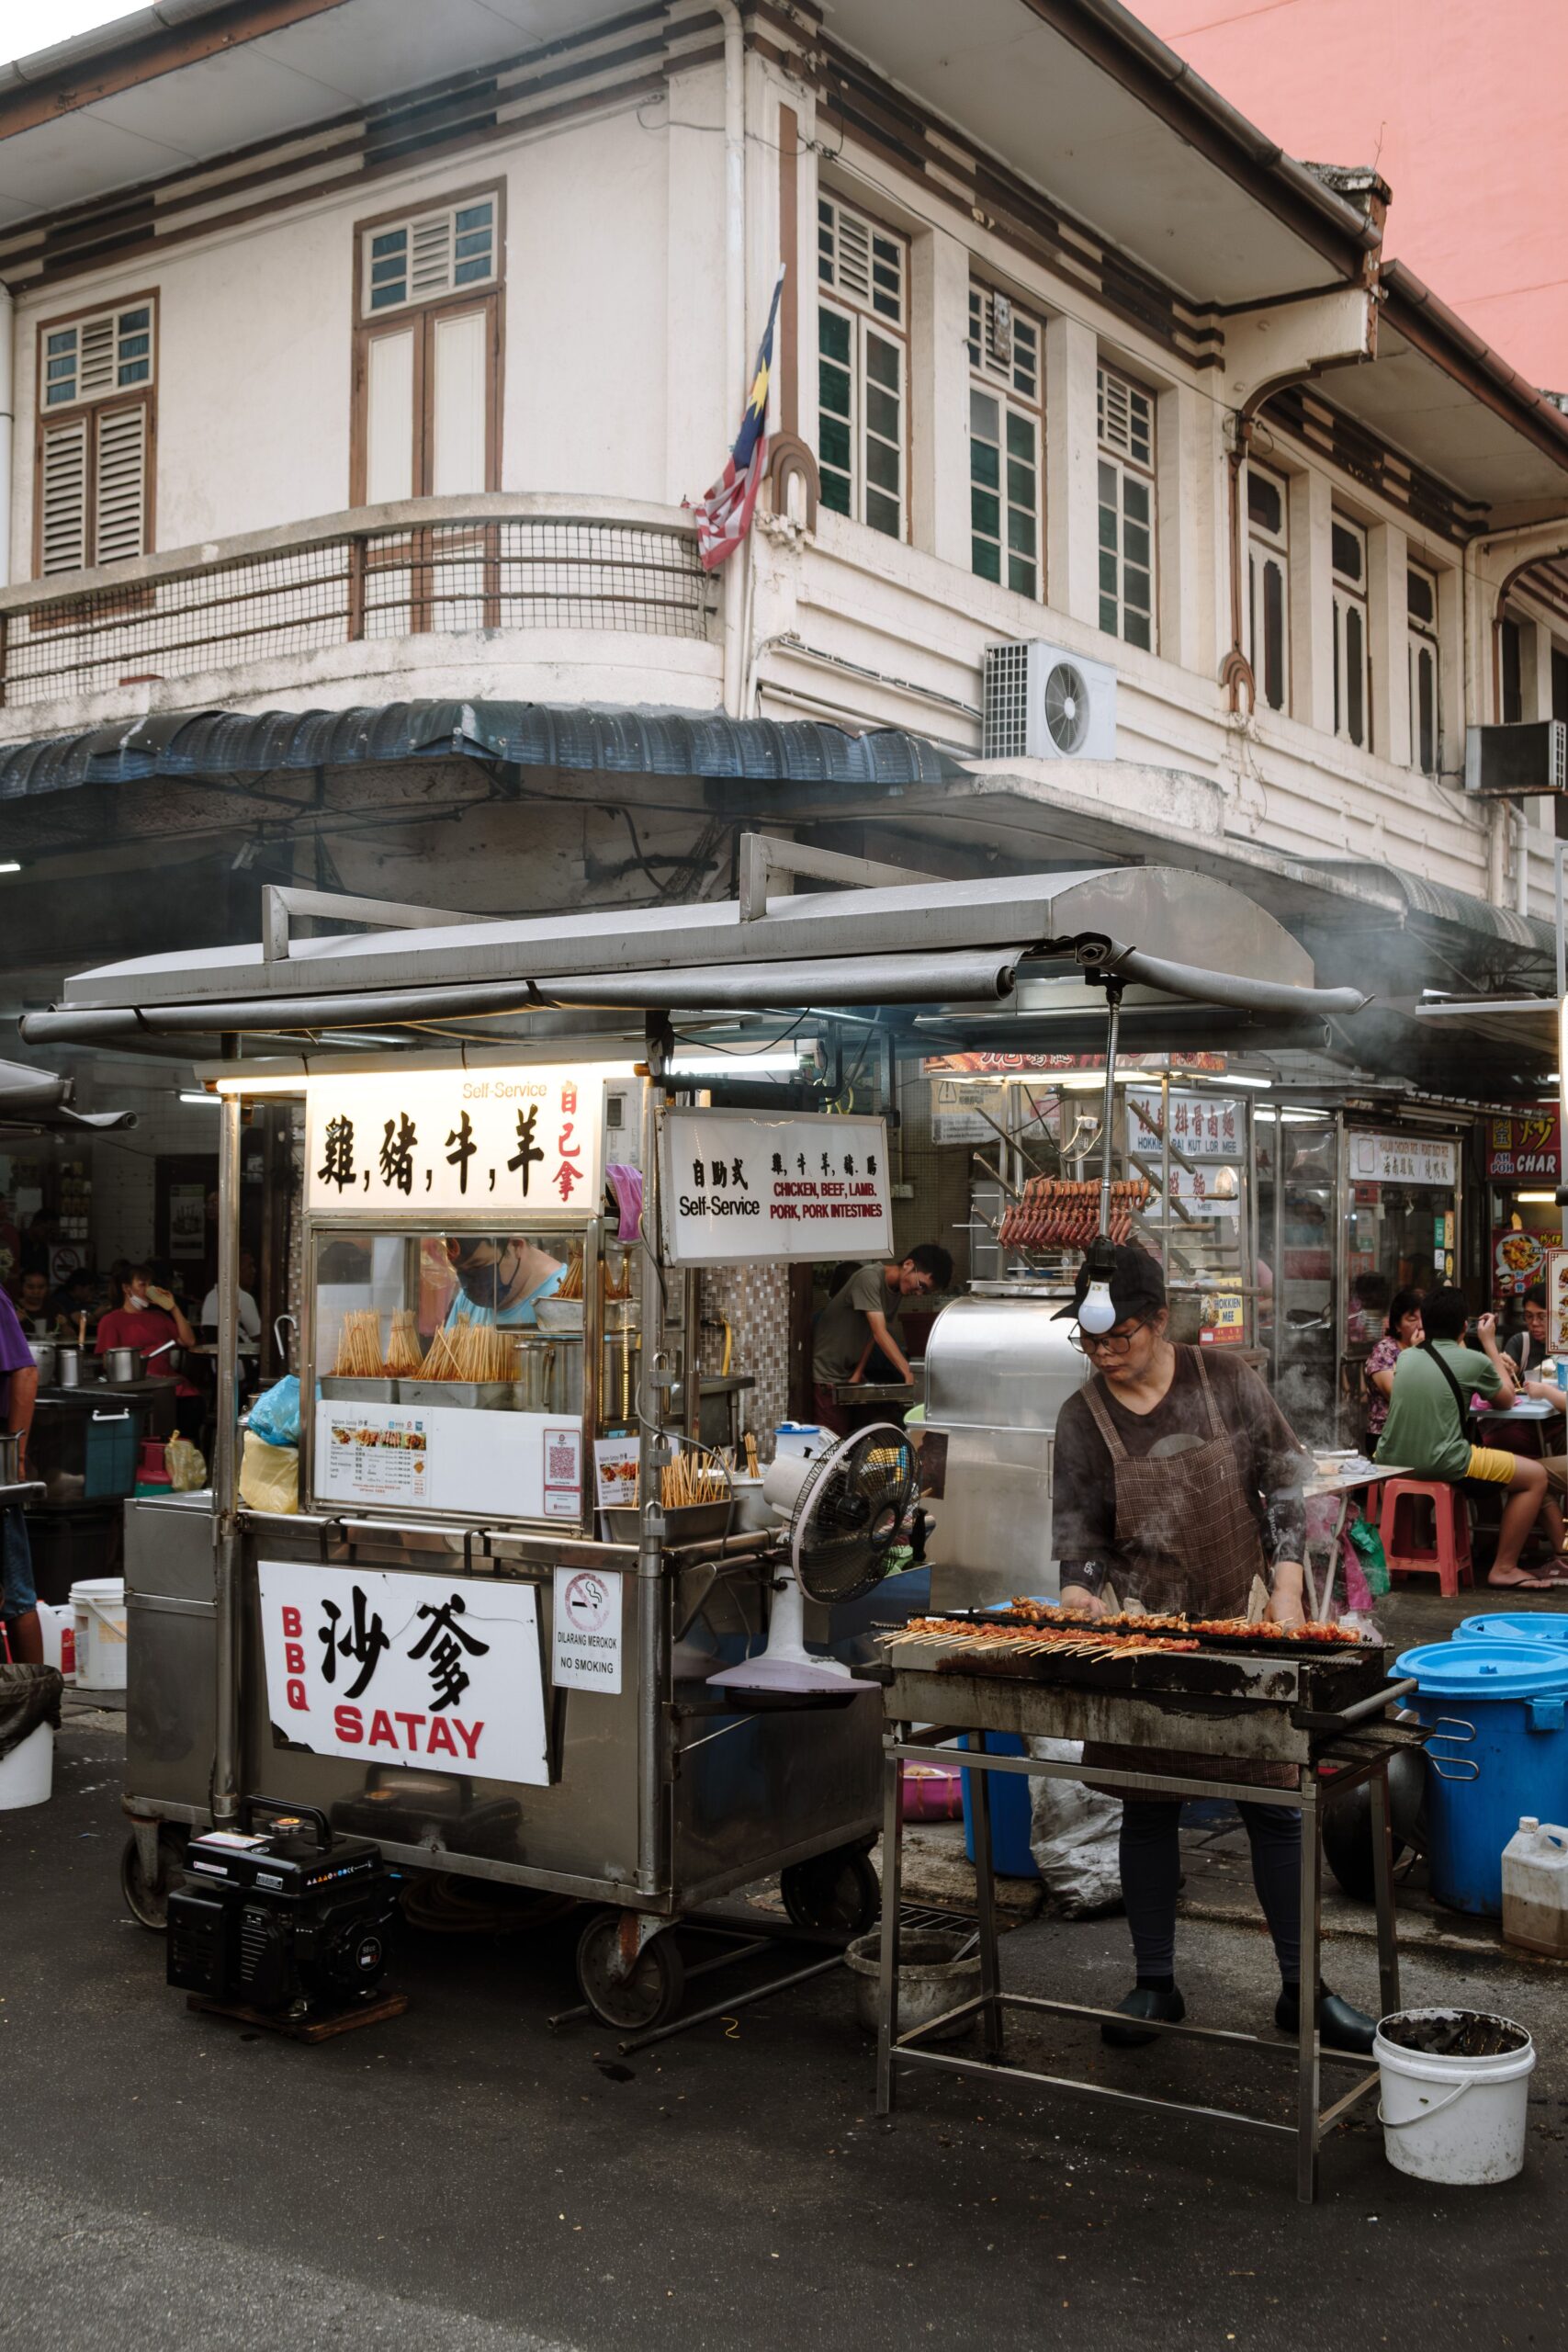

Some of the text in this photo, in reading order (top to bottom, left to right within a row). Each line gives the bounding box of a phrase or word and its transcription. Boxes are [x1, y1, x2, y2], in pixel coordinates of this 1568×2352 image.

[463, 1080, 547, 1100] Self-Service
[552, 1080, 583, 1203] 自己拿
[1137, 1136, 1164, 1150] HOKKIE
[1188, 1139, 1201, 1151] KUT
[1205, 1140, 1219, 1152] LOR
[1223, 1141, 1237, 1153] MEE
[1491, 1162, 1515, 1174] POH
[1495, 1152, 1557, 1174] AH CHAR
[692, 1157, 749, 1191] 自助式
[773, 1182, 819, 1200] CHICKEN,
[820, 1182, 848, 1200] BEEF,
[679, 1195, 761, 1216] Self-Service
[770, 1204, 883, 1222] PORK, PORK INTESTINES
[1213, 1297, 1242, 1310] HOKKIEN
[1222, 1310, 1235, 1323] MEE
[317, 1585, 491, 1713] 沙爹
[557, 1631, 617, 1650] DILARANG MEROKOK
[281, 1605, 310, 1713] BBQ
[560, 1656, 615, 1674] NO SMOKING
[333, 1704, 485, 1760] SATAY
